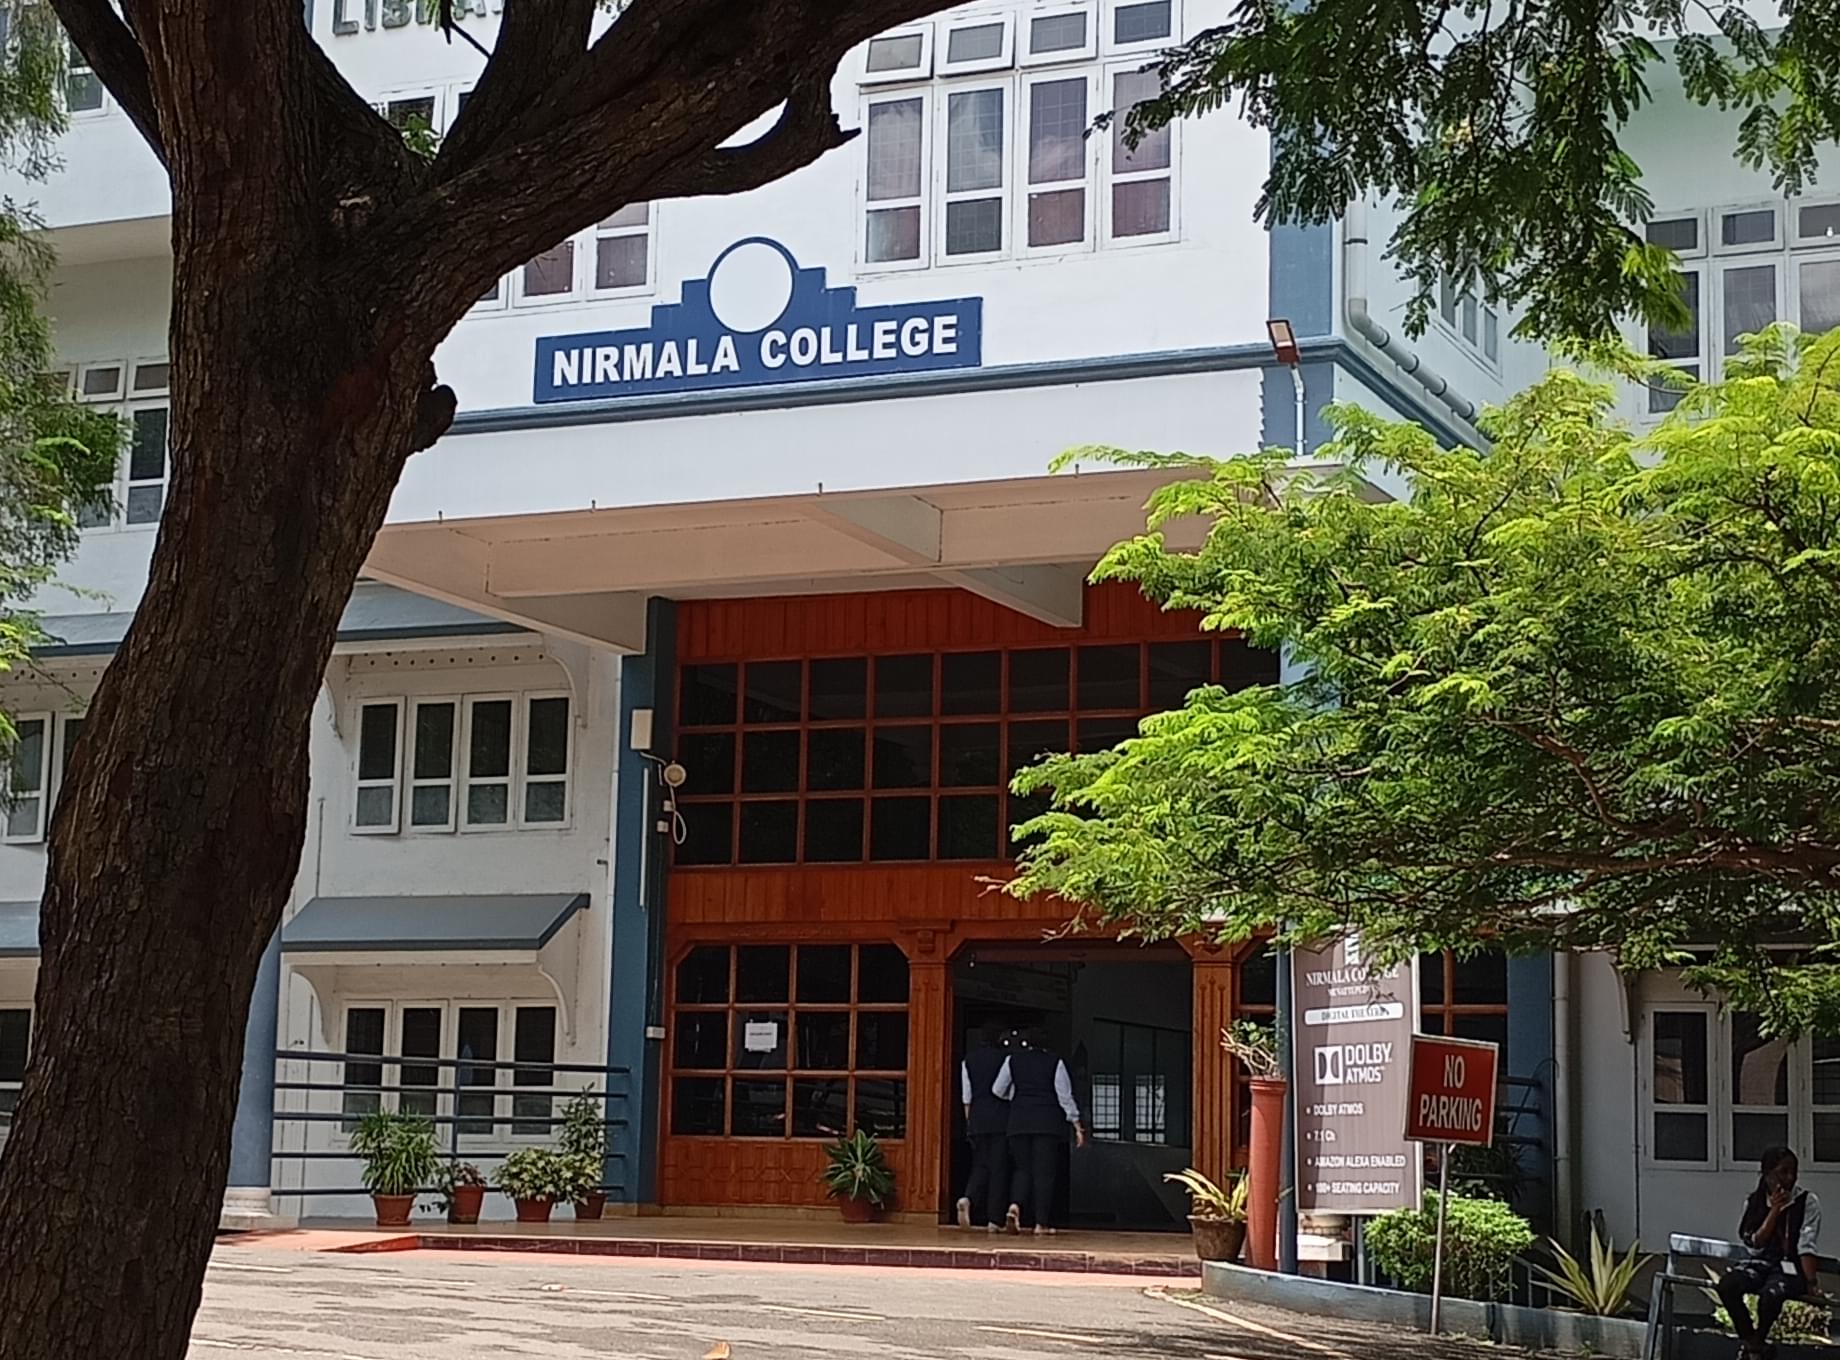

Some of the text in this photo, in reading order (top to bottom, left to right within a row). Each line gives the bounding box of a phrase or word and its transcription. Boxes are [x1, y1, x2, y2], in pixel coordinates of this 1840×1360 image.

[552, 315, 958, 387] NIRMALA COLLEGE
[1306, 969, 1350, 986] NIRMALA
[1345, 1043, 1391, 1066] DOLBY
[1345, 1066, 1382, 1084] ATMOS
[1443, 1054, 1465, 1089] NO
[1313, 1102, 1364, 1116] DOLBY ATMOS
[1418, 1094, 1483, 1133] PARKING
[1314, 1155, 1406, 1167] AMAZON ALEXA ENABLED
[1331, 1182, 1362, 1194] SEATING
[1362, 1182, 1401, 1194] CAPACITY
